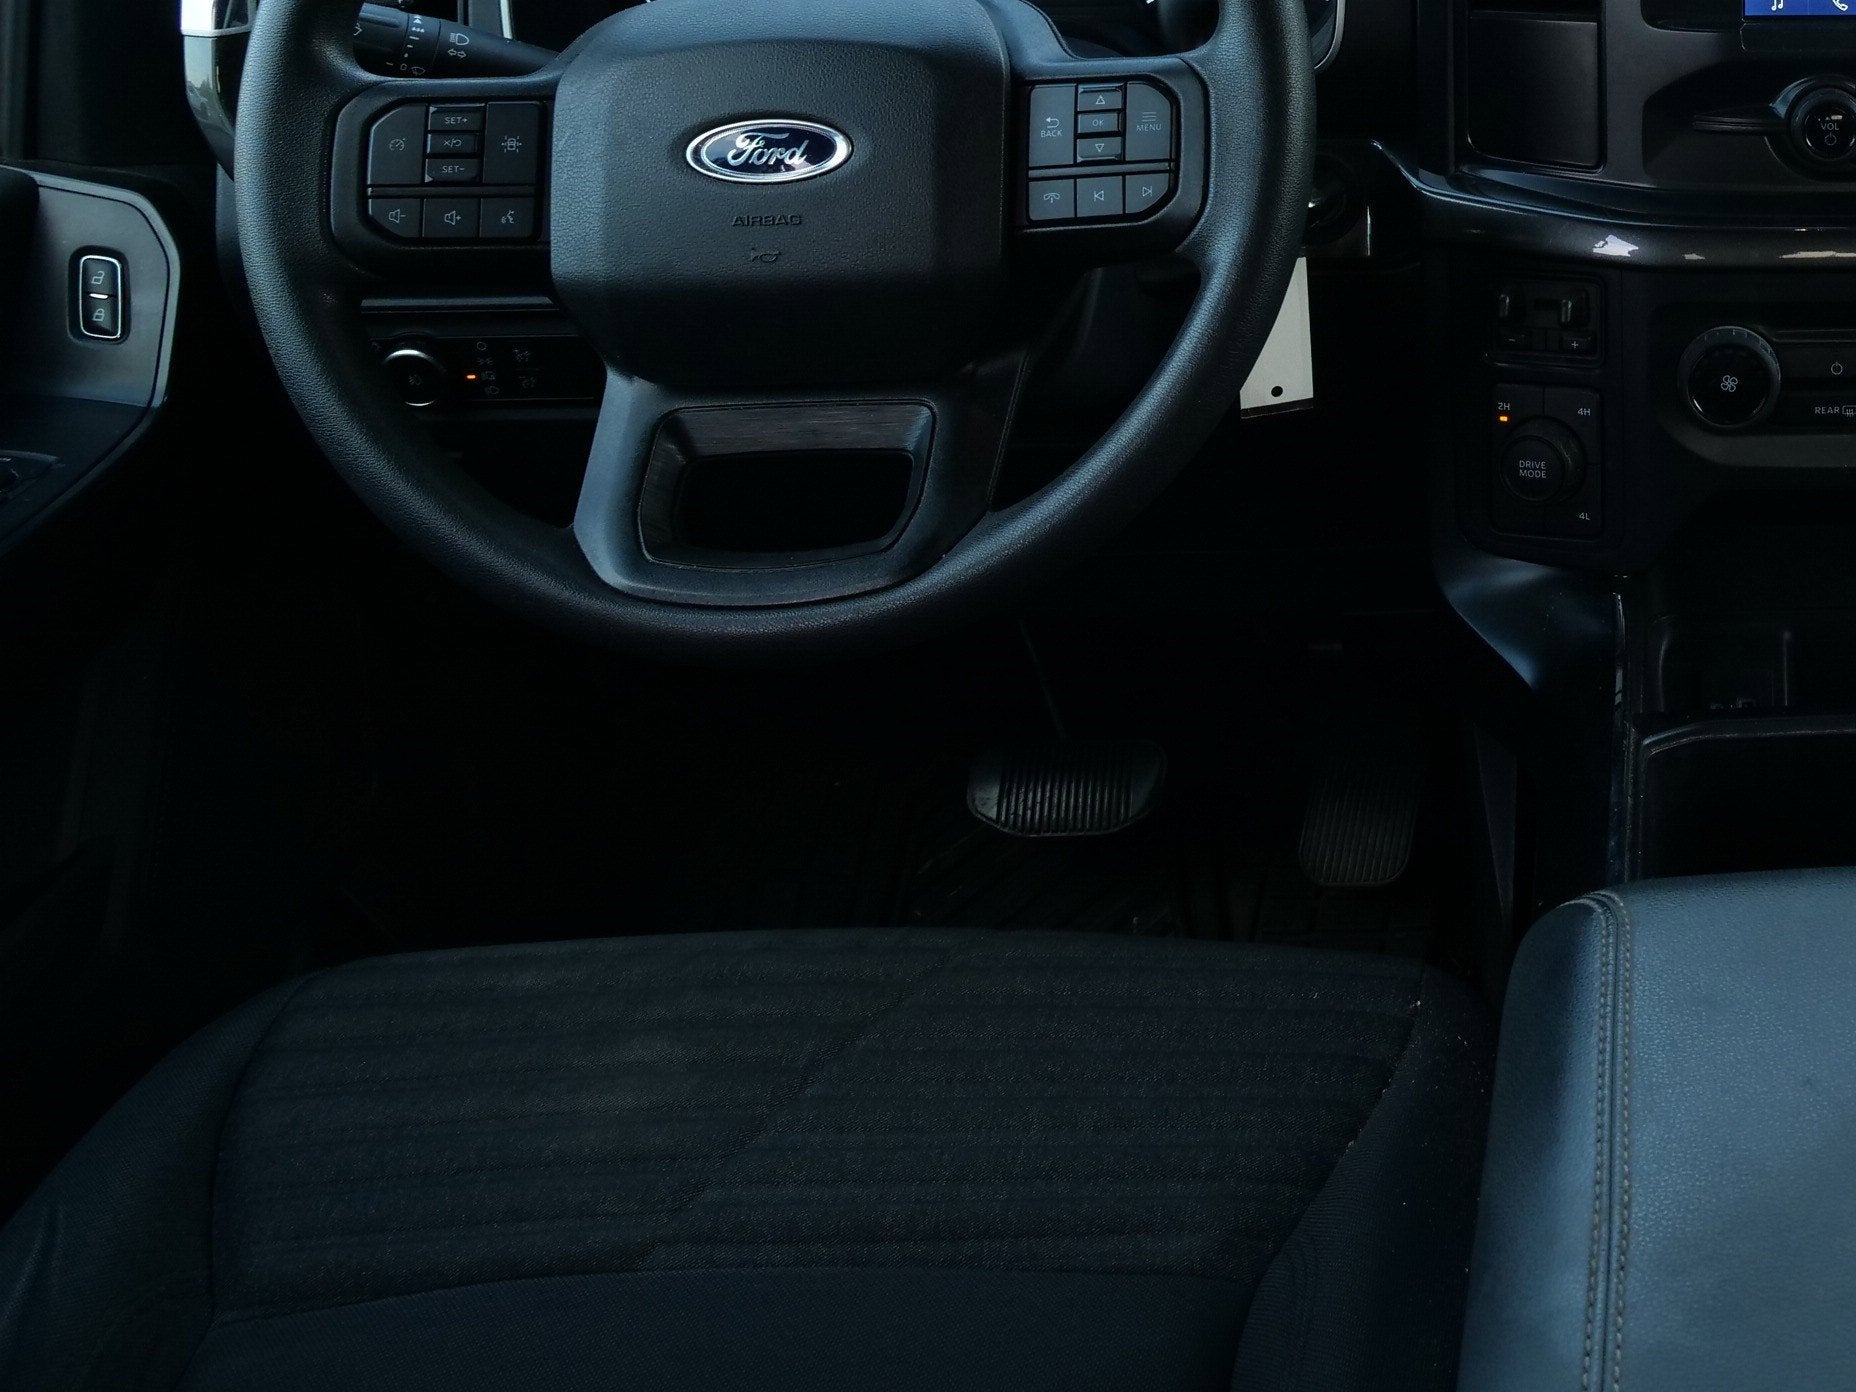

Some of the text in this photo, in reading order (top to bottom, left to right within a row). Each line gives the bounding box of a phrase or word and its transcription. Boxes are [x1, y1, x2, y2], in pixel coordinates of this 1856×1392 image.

[1092, 118, 1104, 128] OK
[1820, 123, 1839, 131] VOL
[1136, 123, 1163, 134] MENU
[1040, 129, 1063, 139] BACK
[727, 131, 810, 167] Ford
[733, 215, 803, 227] AIRBAG
[1497, 402, 1511, 411] 2H
[1814, 406, 1840, 415] REAR
[1577, 408, 1591, 416] 4H
[1518, 460, 1547, 469] DRIVE
[1519, 469, 1547, 478] MODE
[1578, 512, 1591, 520] 4L
